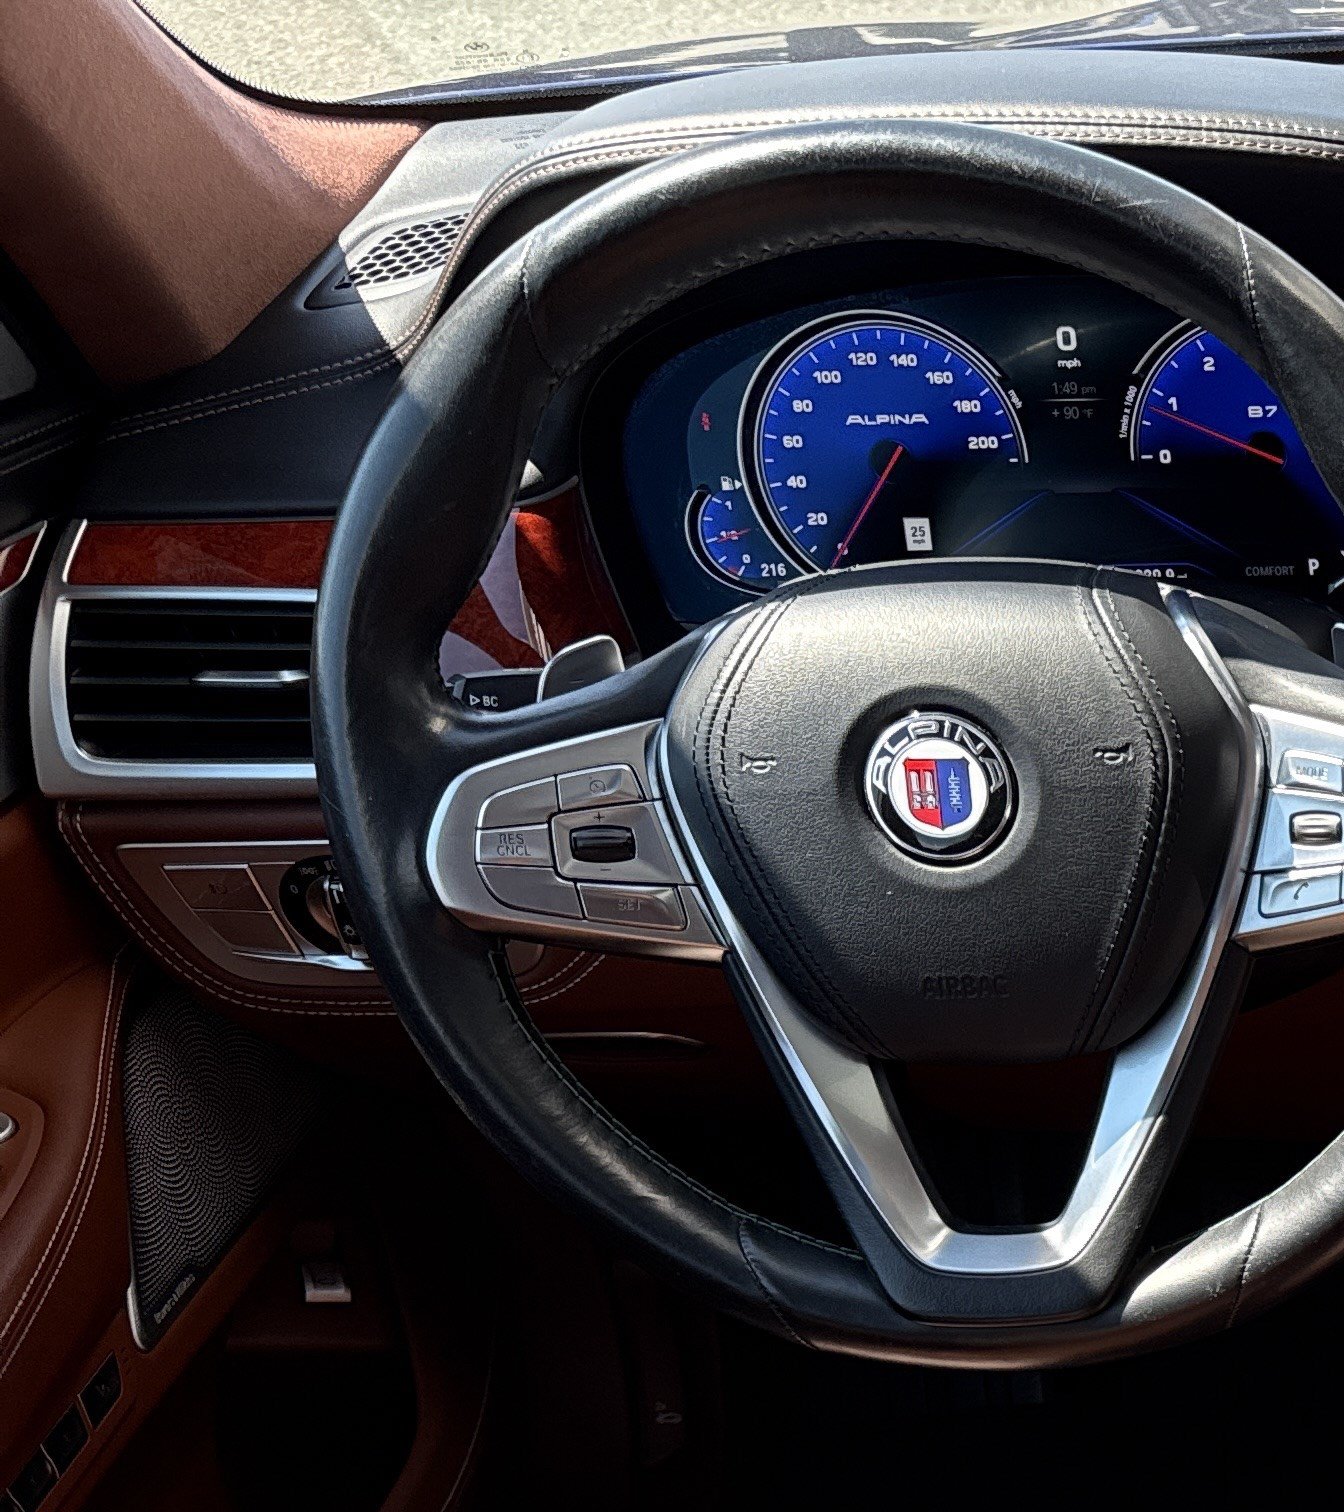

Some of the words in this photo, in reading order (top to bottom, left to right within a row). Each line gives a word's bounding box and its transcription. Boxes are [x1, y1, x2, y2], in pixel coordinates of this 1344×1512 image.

[1055, 326, 1077, 351] 0
[848, 353, 877, 366] 120
[889, 353, 917, 367] 140
[1057, 358, 1082, 370] mph
[1203, 356, 1216, 371] 2
[812, 371, 842, 384] 100
[925, 372, 953, 385] 160
[1051, 381, 1078, 395] 1:49
[1081, 386, 1097, 396] pm
[1008, 389, 1023, 410] mph
[1167, 397, 1178, 412] 1
[792, 400, 813, 413] 80
[952, 400, 981, 413] 180
[1064, 406, 1080, 420] 90
[1248, 405, 1279, 419] B7
[845, 413, 930, 426] ALPINA
[782, 436, 803, 448] 60
[967, 437, 999, 450] 200
[1159, 449, 1172, 464] 0
[786, 475, 807, 488] 40
[725, 500, 733, 510] 1
[806, 512, 828, 526] 20
[910, 525, 926, 537] 25
[742, 554, 751, 564] 0
[760, 563, 787, 577] 216
[1245, 565, 1295, 577] COMFORT
[1307, 558, 1320, 576] P
[482, 695, 499, 707] BC
[872, 718, 1004, 795] ALPINA
[499, 833, 525, 845] RES
[496, 845, 532, 857] CNCL
